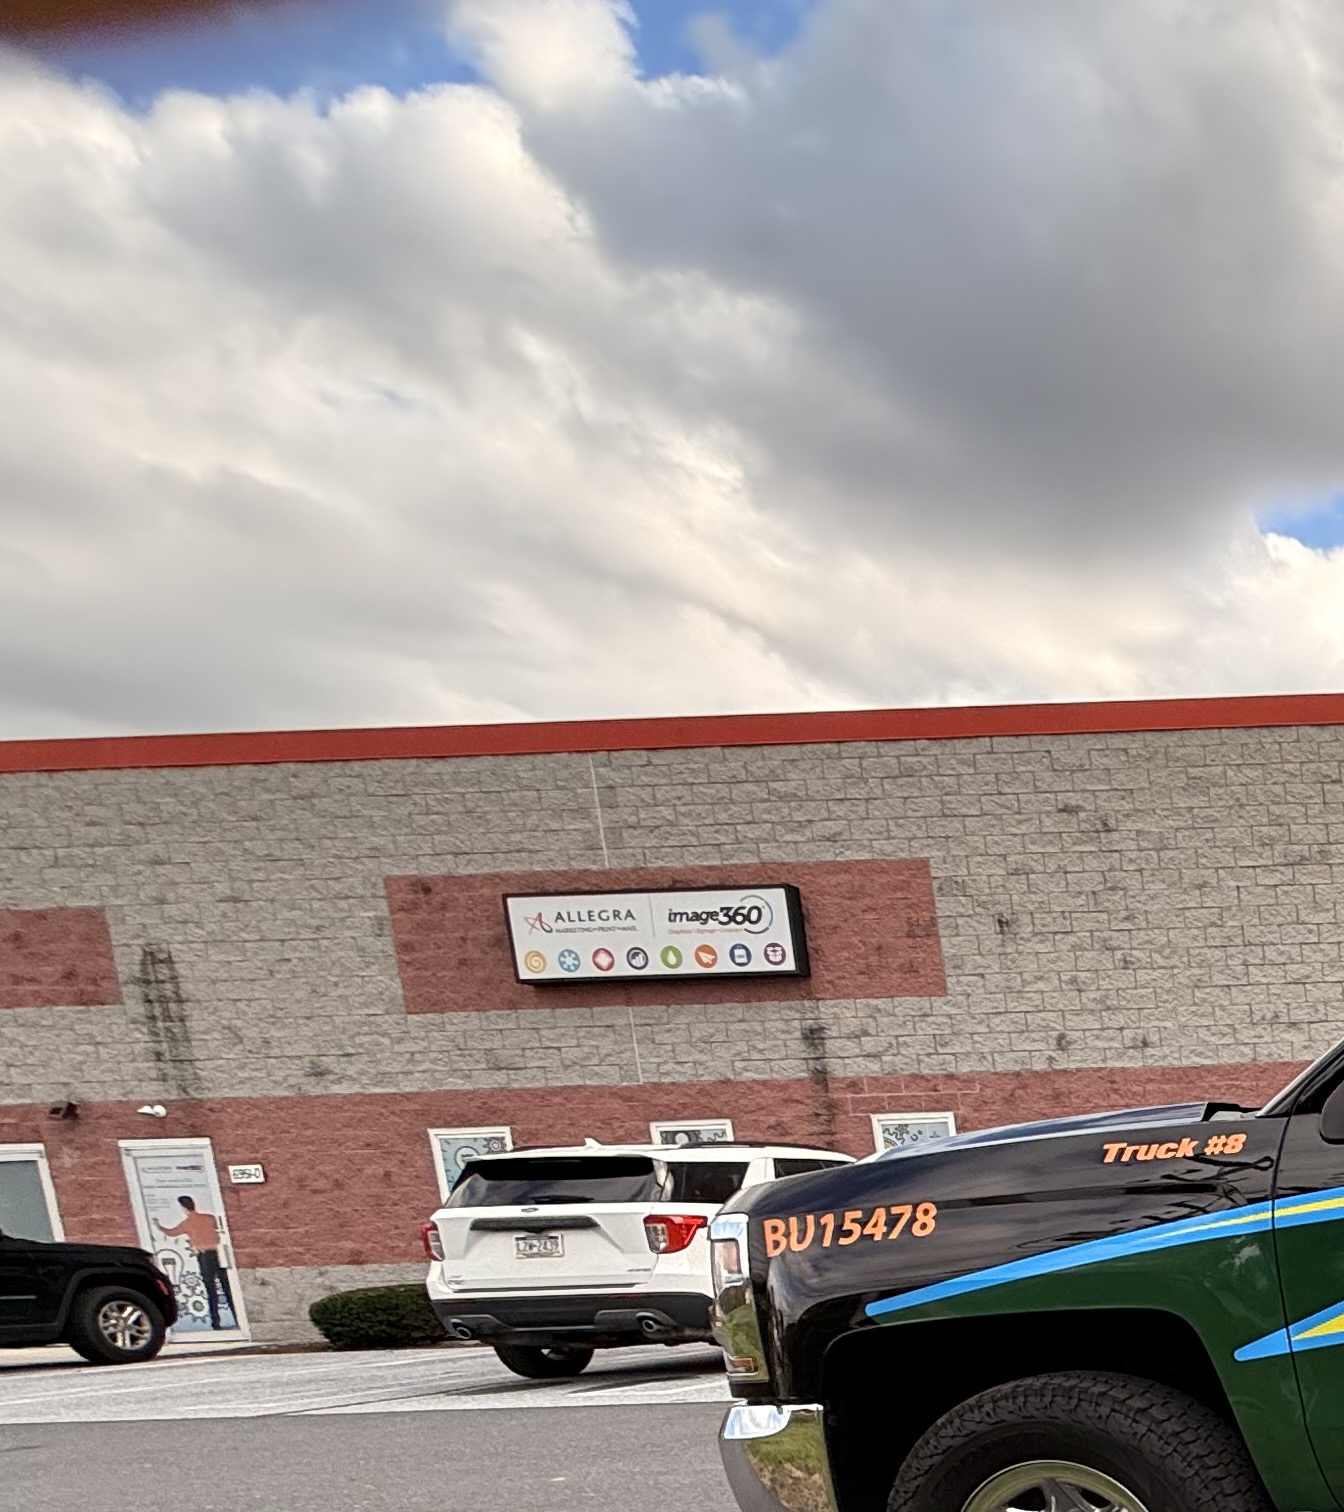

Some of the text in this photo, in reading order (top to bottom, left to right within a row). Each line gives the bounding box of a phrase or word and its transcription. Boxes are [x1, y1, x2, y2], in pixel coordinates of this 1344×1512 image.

[554, 909, 636, 923] ALLEGRA
[667, 905, 763, 926] image360
[1102, 1133, 1247, 1163] Truck #8
[763, 1202, 938, 1258] BU15478
